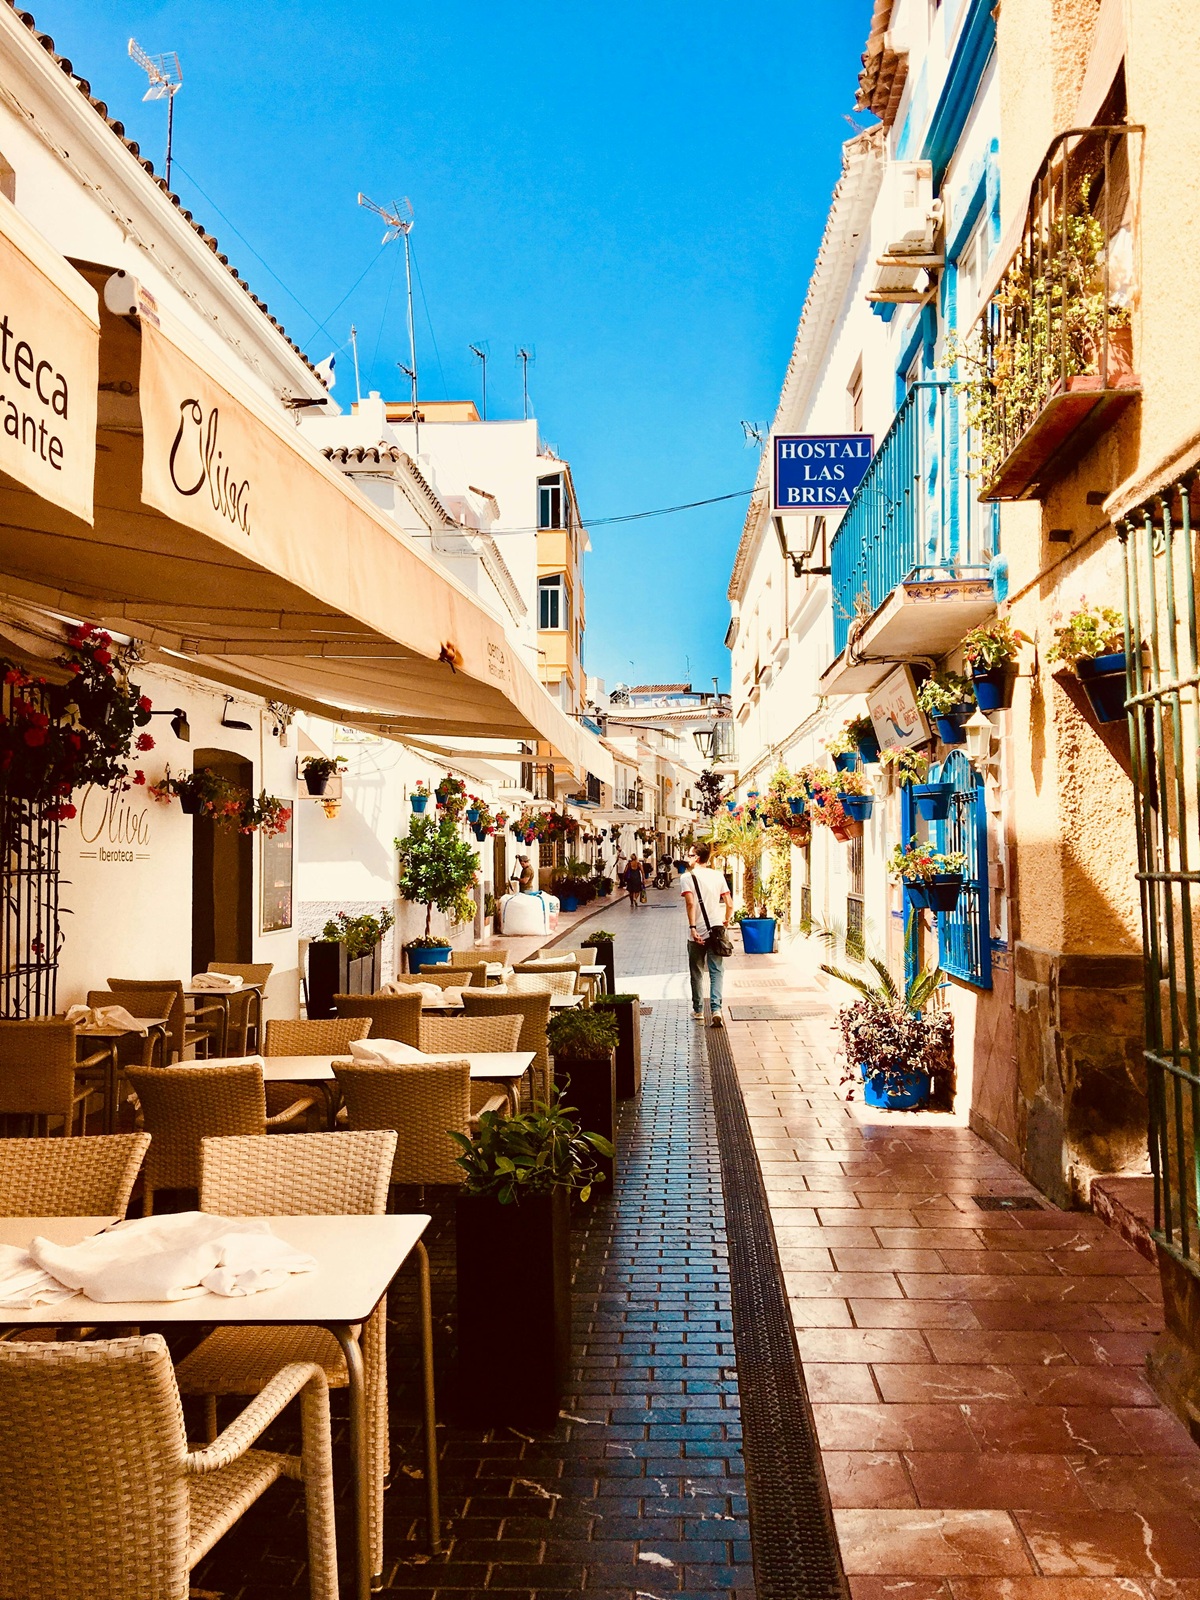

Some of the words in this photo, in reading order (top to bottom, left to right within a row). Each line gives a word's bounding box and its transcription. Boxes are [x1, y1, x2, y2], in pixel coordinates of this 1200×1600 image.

[781, 442, 870, 459] HOSTAL
[169, 398, 251, 536] Oliva
[804, 464, 845, 481] LAS
[99, 847, 134, 862] Iberoteca
